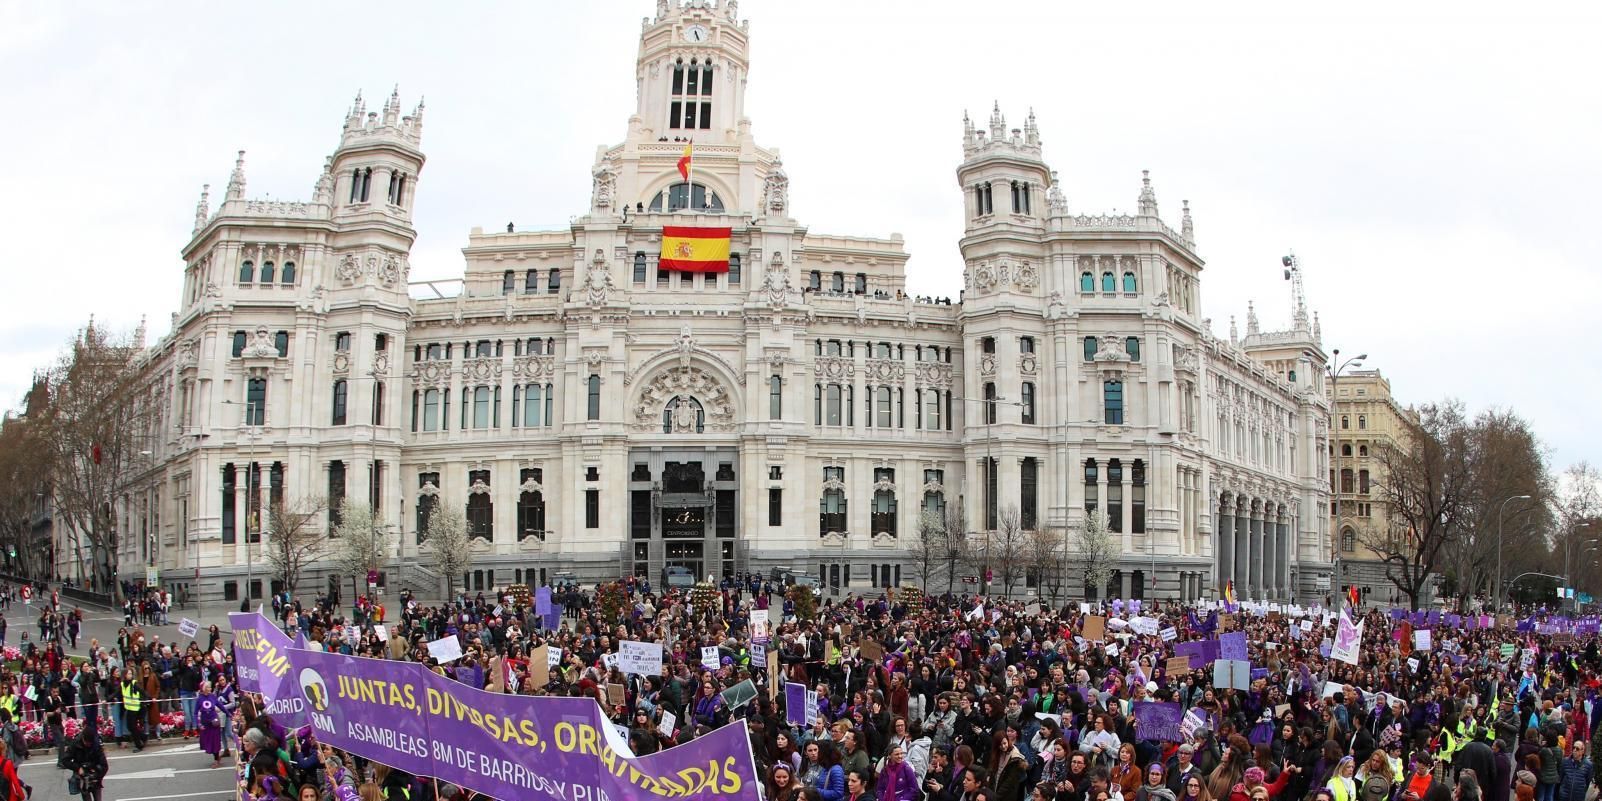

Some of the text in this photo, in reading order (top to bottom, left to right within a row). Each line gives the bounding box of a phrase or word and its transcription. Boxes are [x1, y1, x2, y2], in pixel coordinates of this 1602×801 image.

[338, 674, 422, 716] JUNTAS,
[311, 711, 337, 735] 8M
[348, 721, 429, 758] ASAMBLEAS
[432, 740, 454, 766] 8M
[456, 747, 477, 773] DE
[480, 754, 554, 795] BARRIOS
[553, 780, 566, 800] Y
